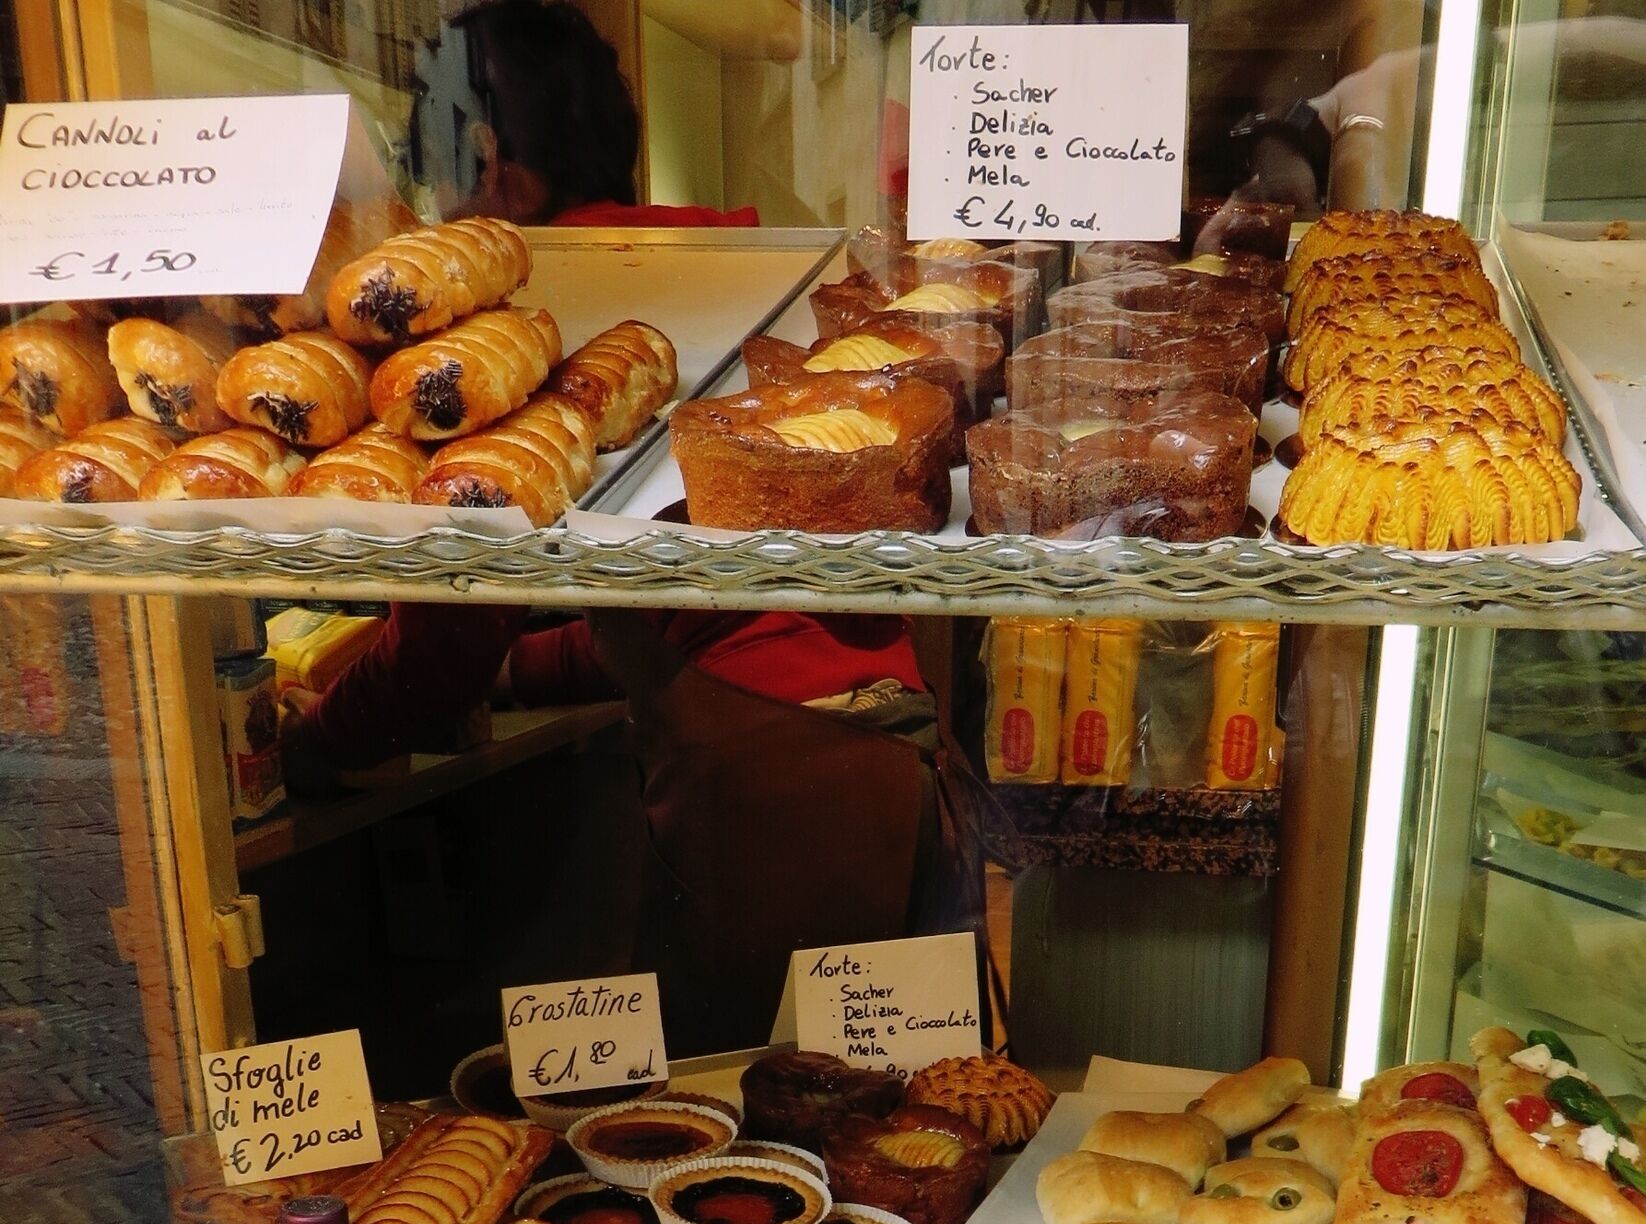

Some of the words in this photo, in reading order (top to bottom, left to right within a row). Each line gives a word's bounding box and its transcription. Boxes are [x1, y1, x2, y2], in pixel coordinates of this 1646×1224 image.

[919, 35, 1010, 72] Torte:
[971, 79, 1058, 104] Sacher
[196, 116, 236, 142] al
[970, 110, 1054, 136] Delizia
[968, 138, 1017, 160] Pere
[1035, 147, 1048, 160] e
[1066, 137, 1176, 162] Cioccolato
[968, 165, 1030, 187] Mela
[810, 952, 872, 978] Torte:
[840, 983, 894, 1002] Sacher
[508, 985, 642, 1028] Crostatine
[844, 1003, 903, 1021] Delizia
[844, 1024, 876, 1039] Pere
[887, 1025, 896, 1035] e
[905, 1009, 977, 1030] Cioccolato
[848, 1042, 888, 1057] Mela
[209, 1045, 321, 1098] Sfoglie
[627, 1049, 656, 1080] cad
[213, 1097, 239, 1131] di
[253, 1082, 320, 1123] mele
[327, 1120, 363, 1144] cad
